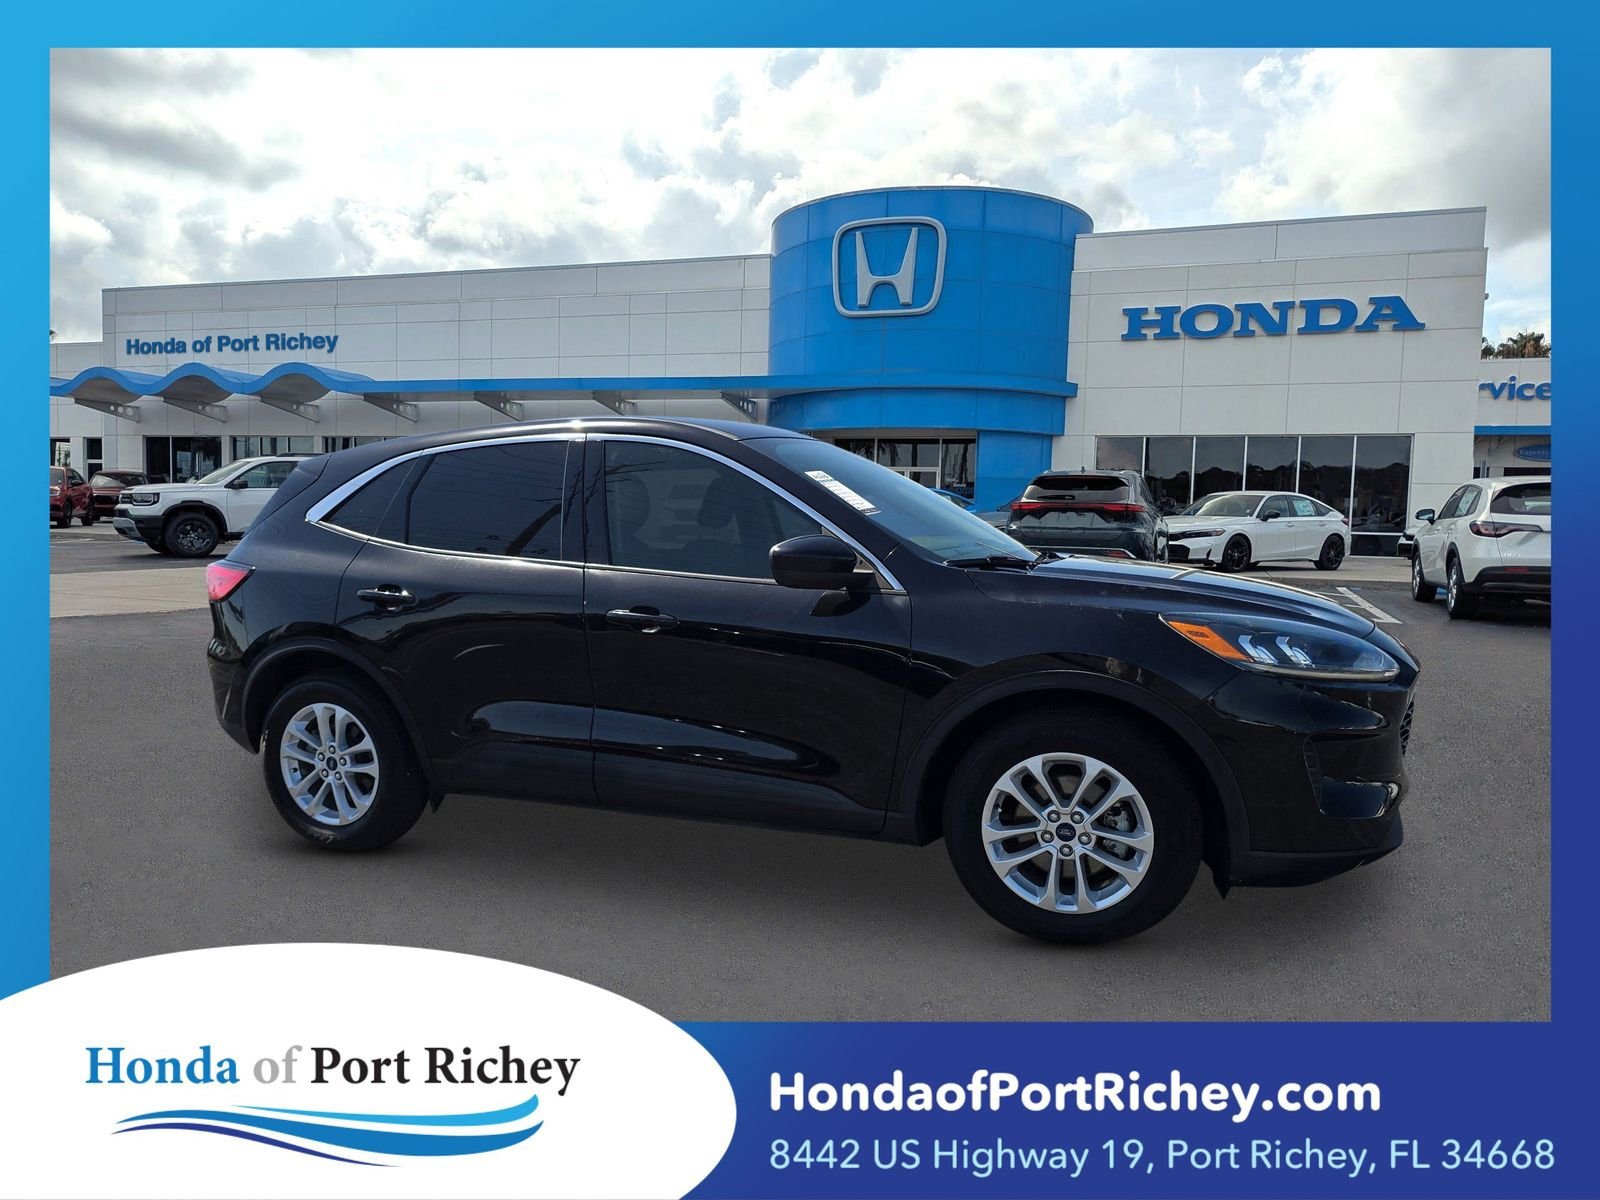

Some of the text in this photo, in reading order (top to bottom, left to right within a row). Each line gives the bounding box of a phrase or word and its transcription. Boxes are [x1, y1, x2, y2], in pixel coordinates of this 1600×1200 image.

[1121, 296, 1425, 341] HONDA
[126, 332, 339, 355] Honda of Port Richey
